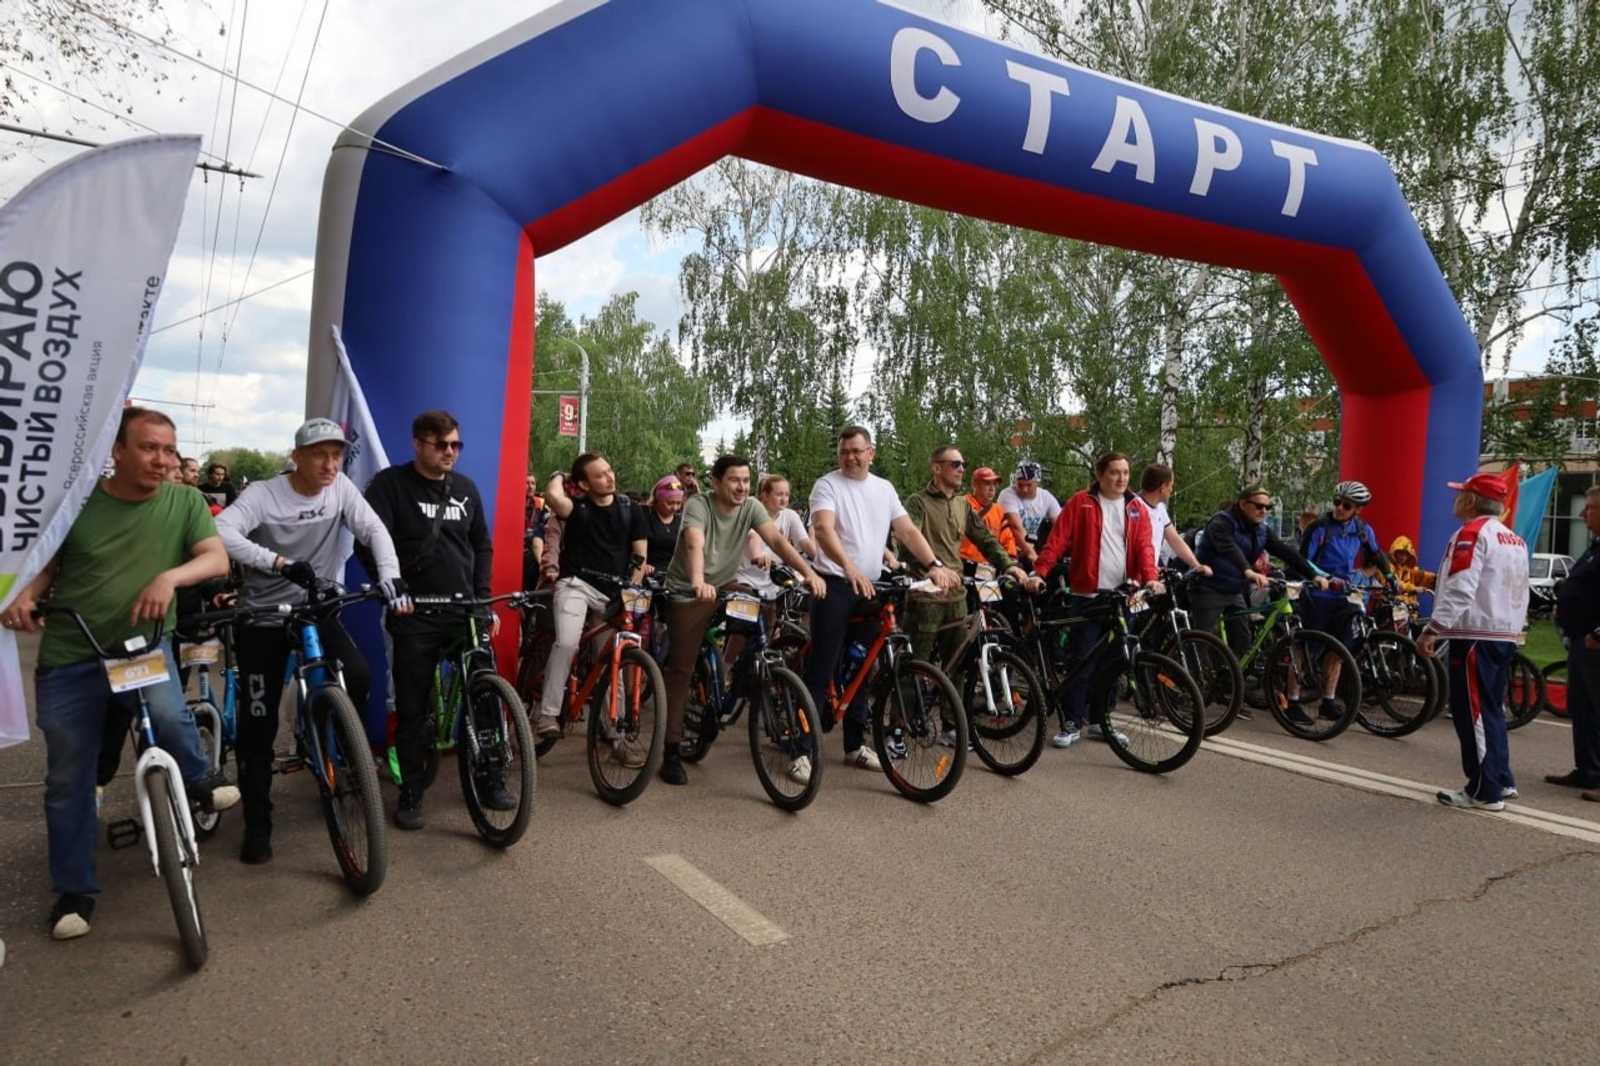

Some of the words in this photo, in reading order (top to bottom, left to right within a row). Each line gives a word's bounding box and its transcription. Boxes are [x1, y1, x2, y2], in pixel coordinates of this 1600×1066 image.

[890, 27, 1318, 218] СТАРТ
[33, 267, 83, 404] ВОЗДУХ
[87, 341, 103, 382] акция
[0, 261, 43, 552] ИРАЮ
[564, 404, 574, 421] 9
[11, 412, 57, 552] ЧИСТЫЙ
